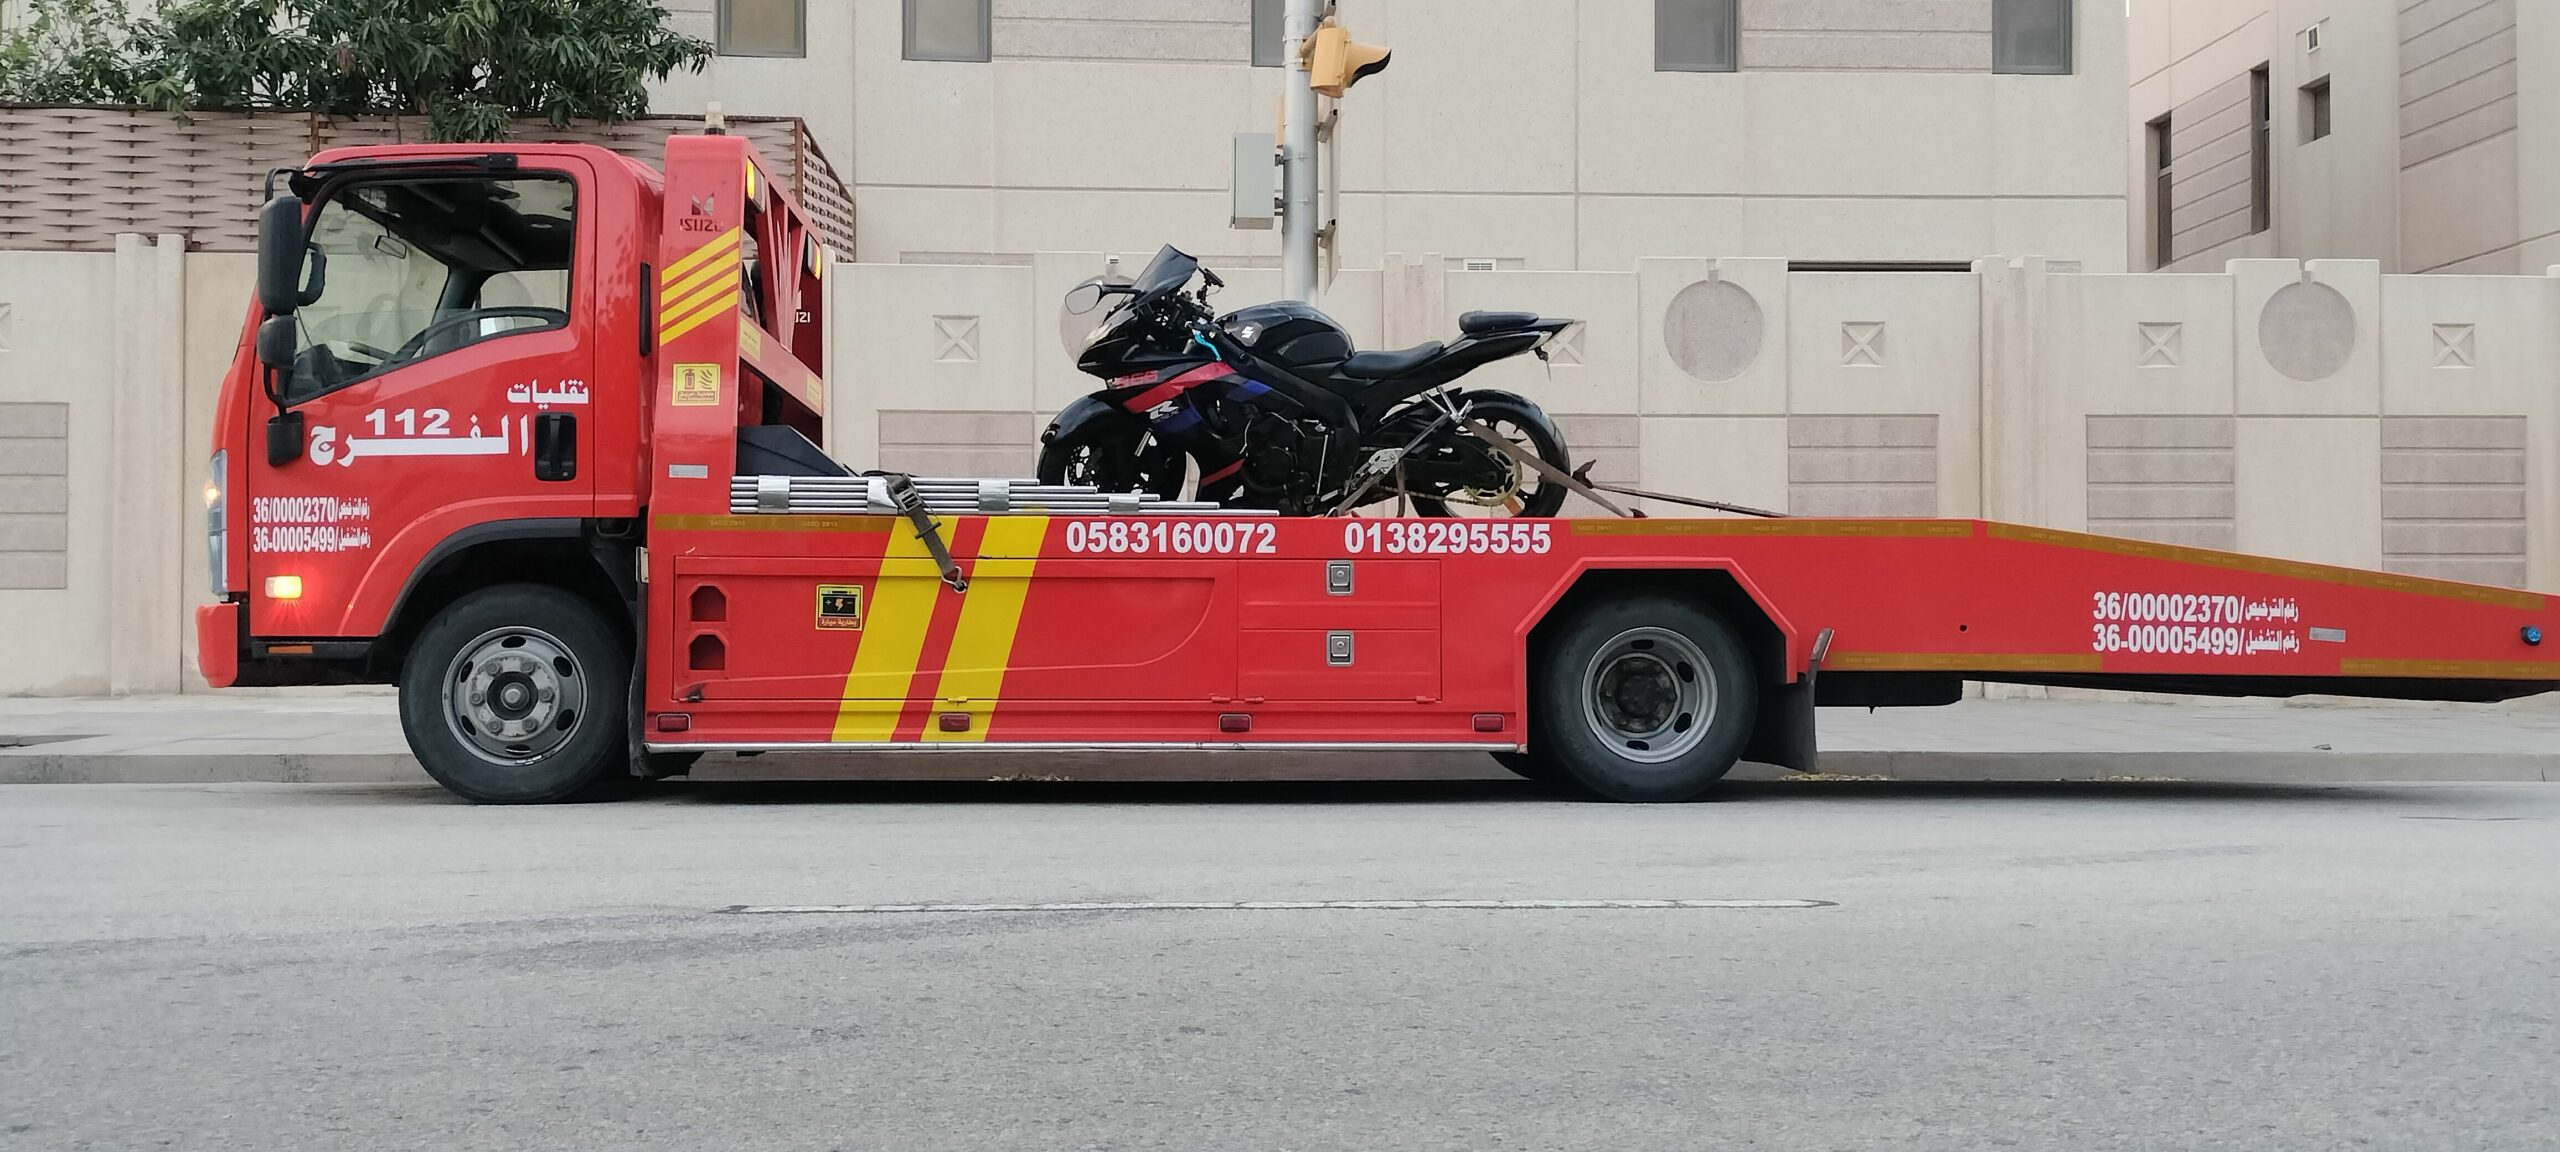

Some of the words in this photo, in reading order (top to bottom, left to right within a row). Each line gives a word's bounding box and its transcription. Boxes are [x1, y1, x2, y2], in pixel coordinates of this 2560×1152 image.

[506, 379, 589, 410] نقليات
[365, 408, 450, 436] 112
[309, 414, 529, 468] الفرج
[1066, 522, 1277, 554] 0583160072
[1344, 523, 1551, 554] 0138295555
